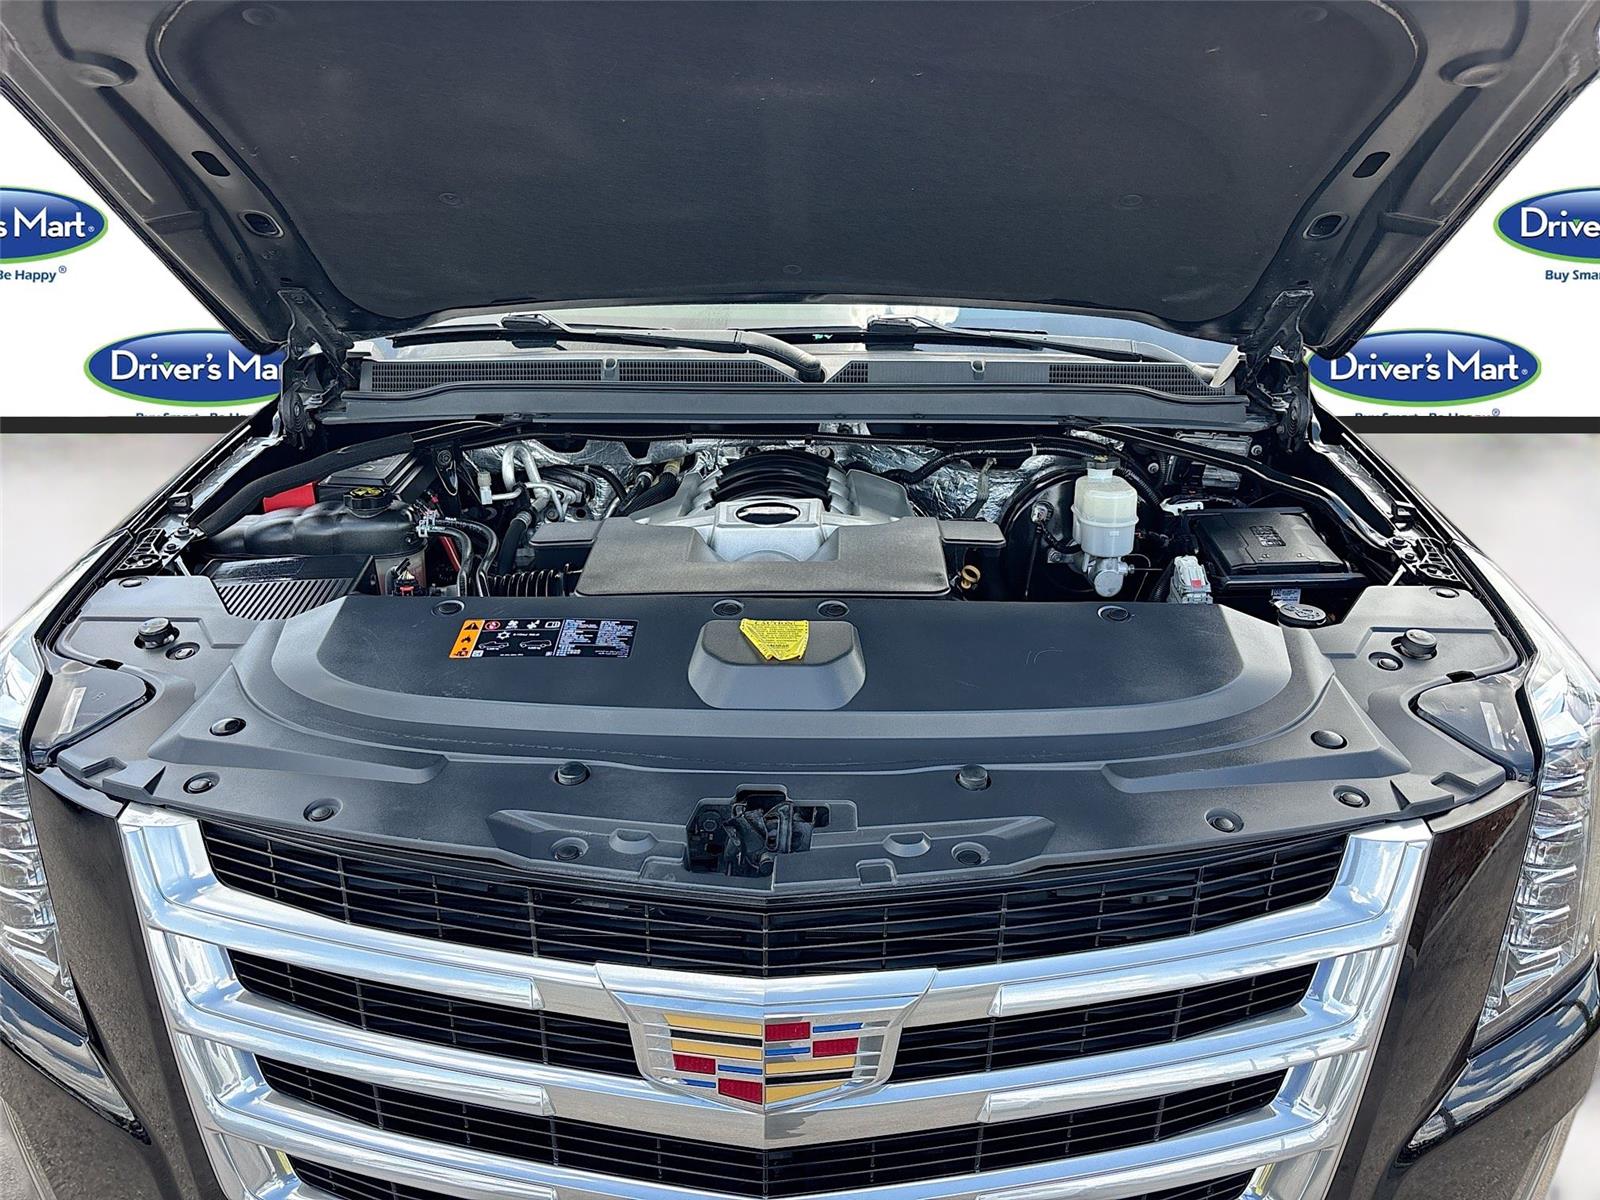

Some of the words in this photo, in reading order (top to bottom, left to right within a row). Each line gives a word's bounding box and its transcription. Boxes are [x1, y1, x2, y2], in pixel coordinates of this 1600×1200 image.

[13, 206, 86, 238] Mart
[1520, 206, 1600, 238] Drive
[14, 269, 57, 283] Happy
[1545, 269, 1570, 283] Buy
[1572, 269, 1600, 280] Sma
[111, 349, 222, 380] Driver's
[228, 349, 282, 380] Ma
[1330, 352, 1441, 380] Driver's
[1447, 348, 1520, 380] Mart
